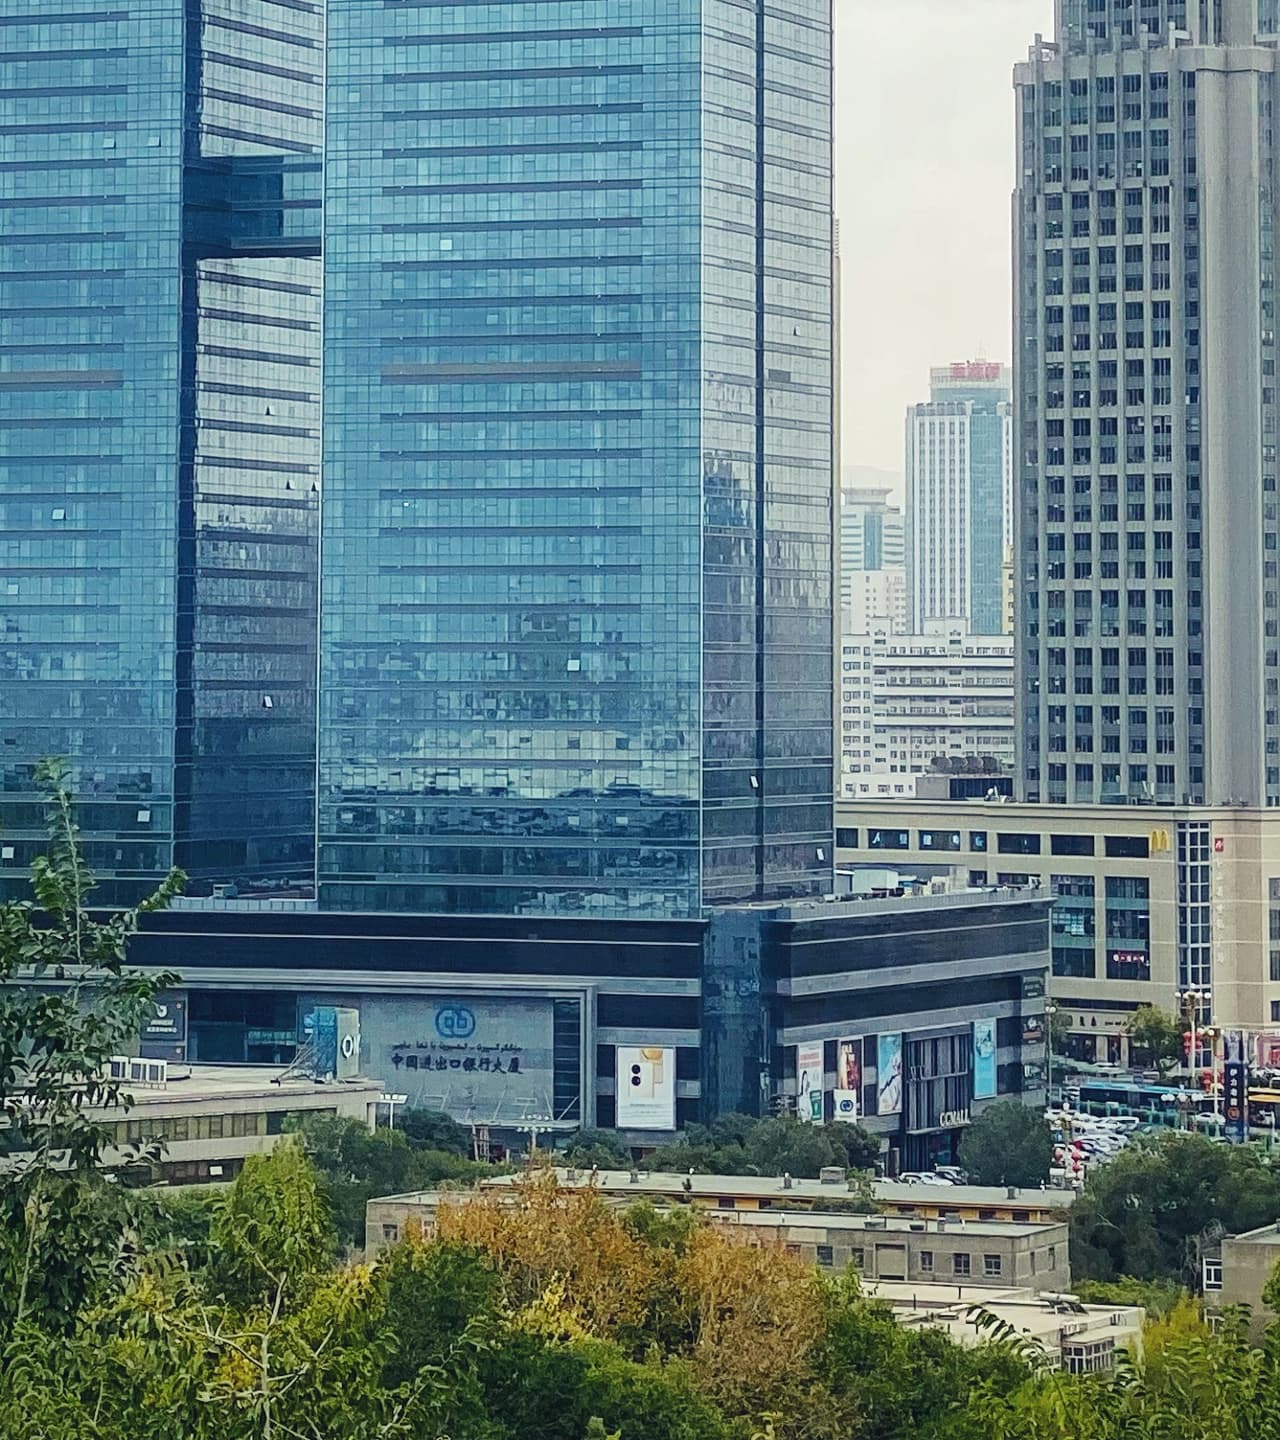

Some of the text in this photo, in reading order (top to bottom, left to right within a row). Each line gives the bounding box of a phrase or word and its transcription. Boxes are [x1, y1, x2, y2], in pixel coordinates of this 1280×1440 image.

[391, 1053, 523, 1074] 中国进出口银行大厦
